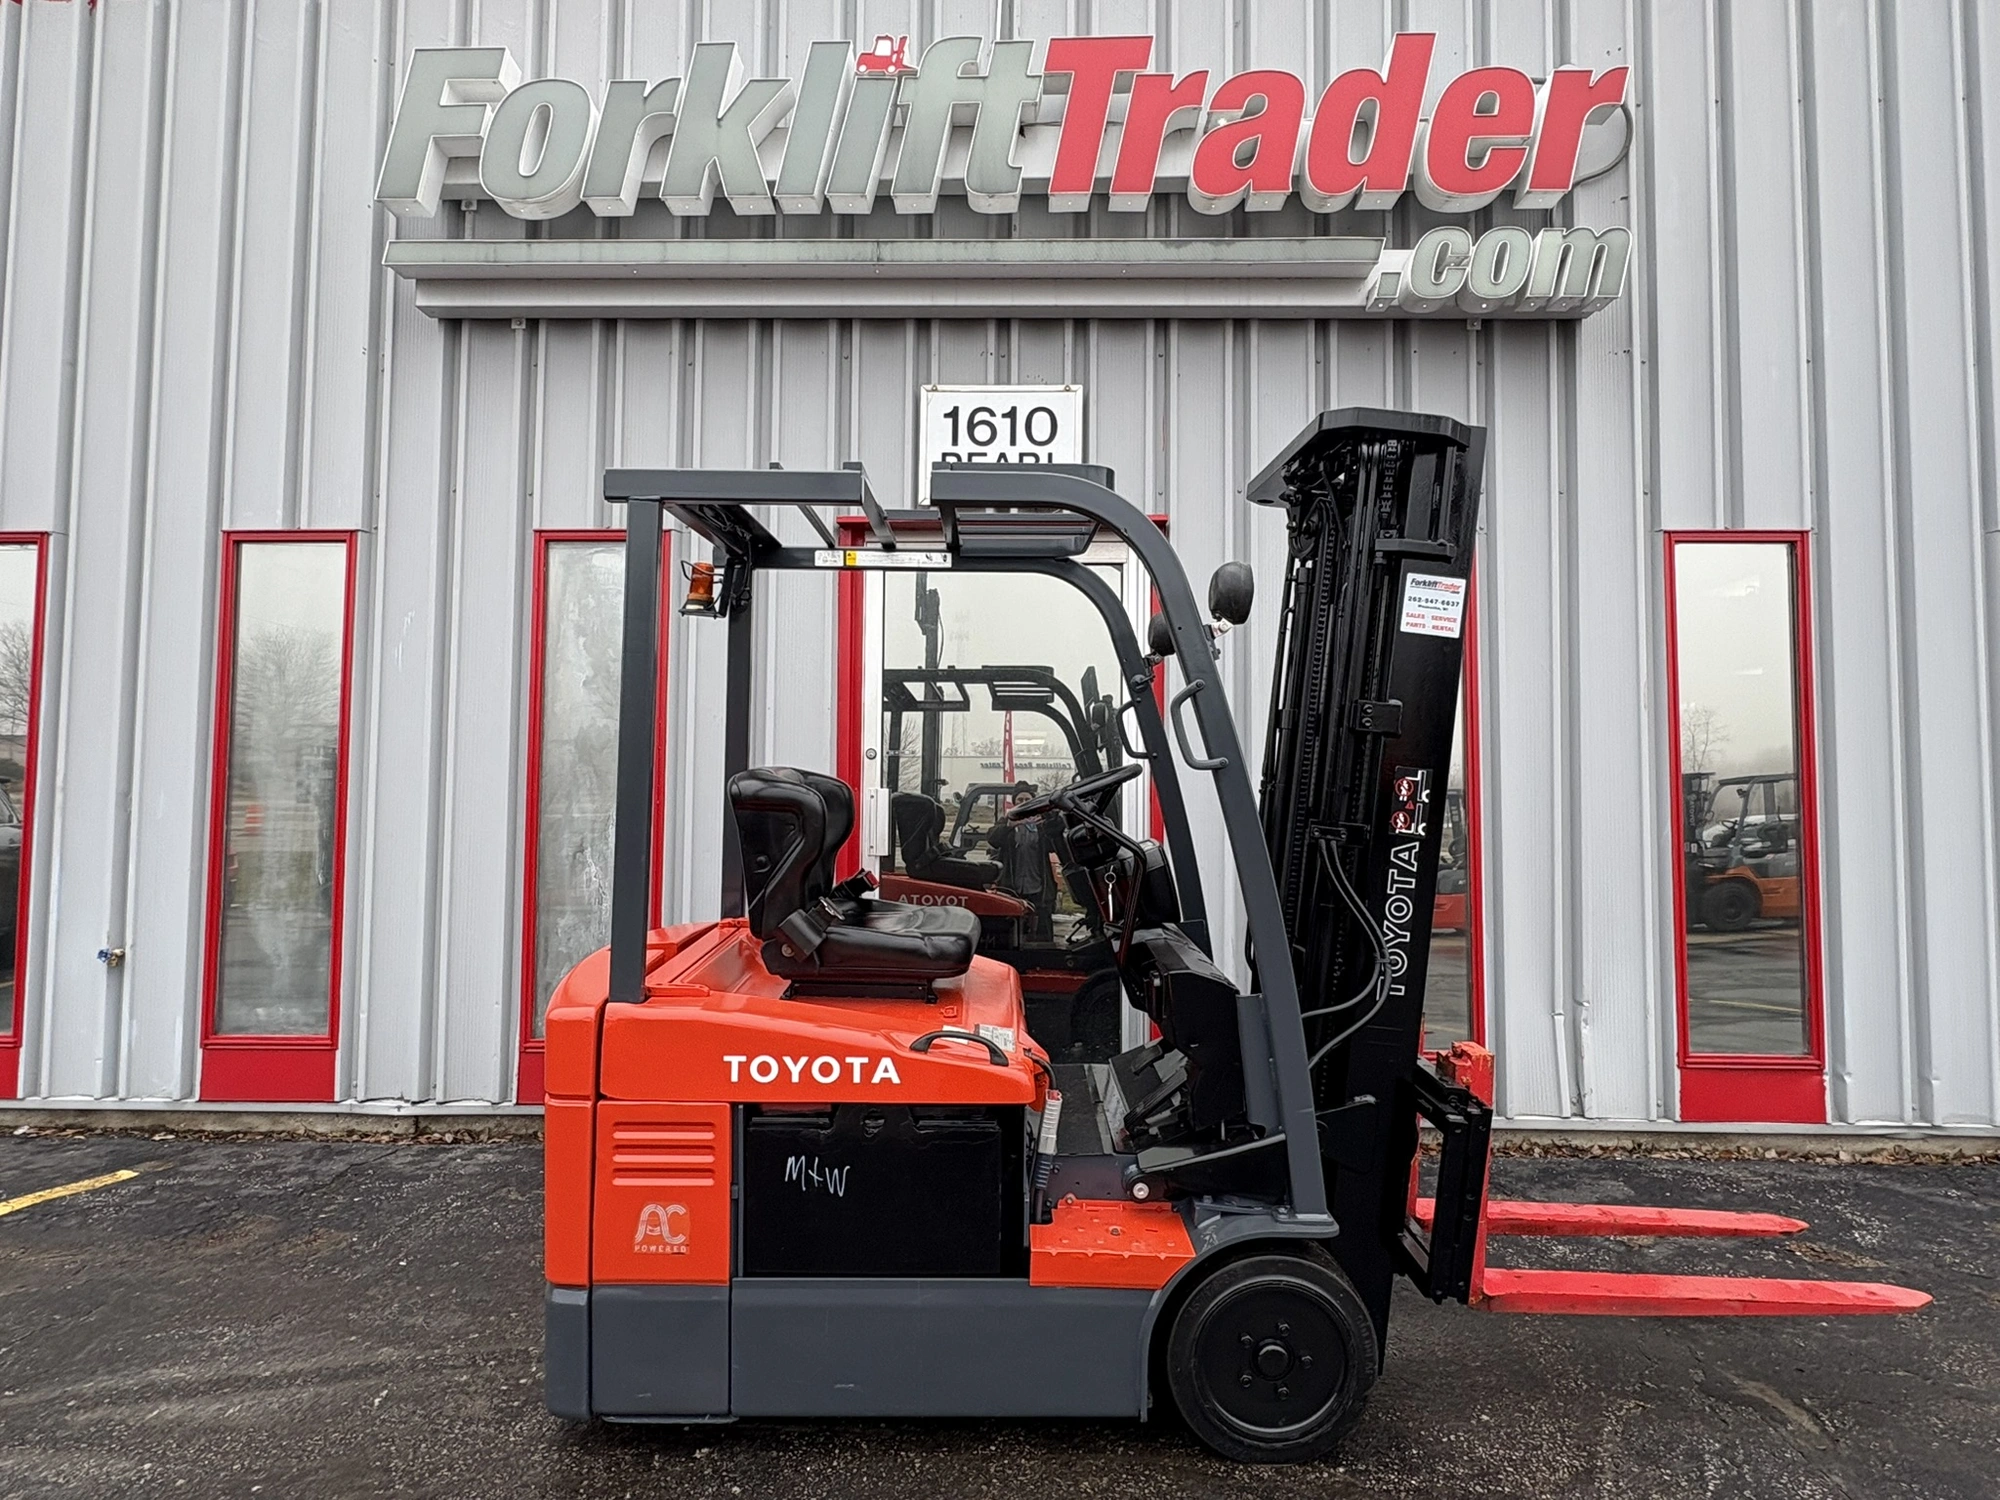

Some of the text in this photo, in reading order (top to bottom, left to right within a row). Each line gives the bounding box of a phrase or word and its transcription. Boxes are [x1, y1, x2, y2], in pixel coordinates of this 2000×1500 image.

[1376, 226, 1633, 299] .com
[943, 405, 1058, 447] 1610
[1406, 612, 1457, 623] SALES SERVICE
[723, 1054, 901, 1084] TOYOTA
[634, 1204, 687, 1244] AC
[633, 1245, 687, 1253] POWERED
